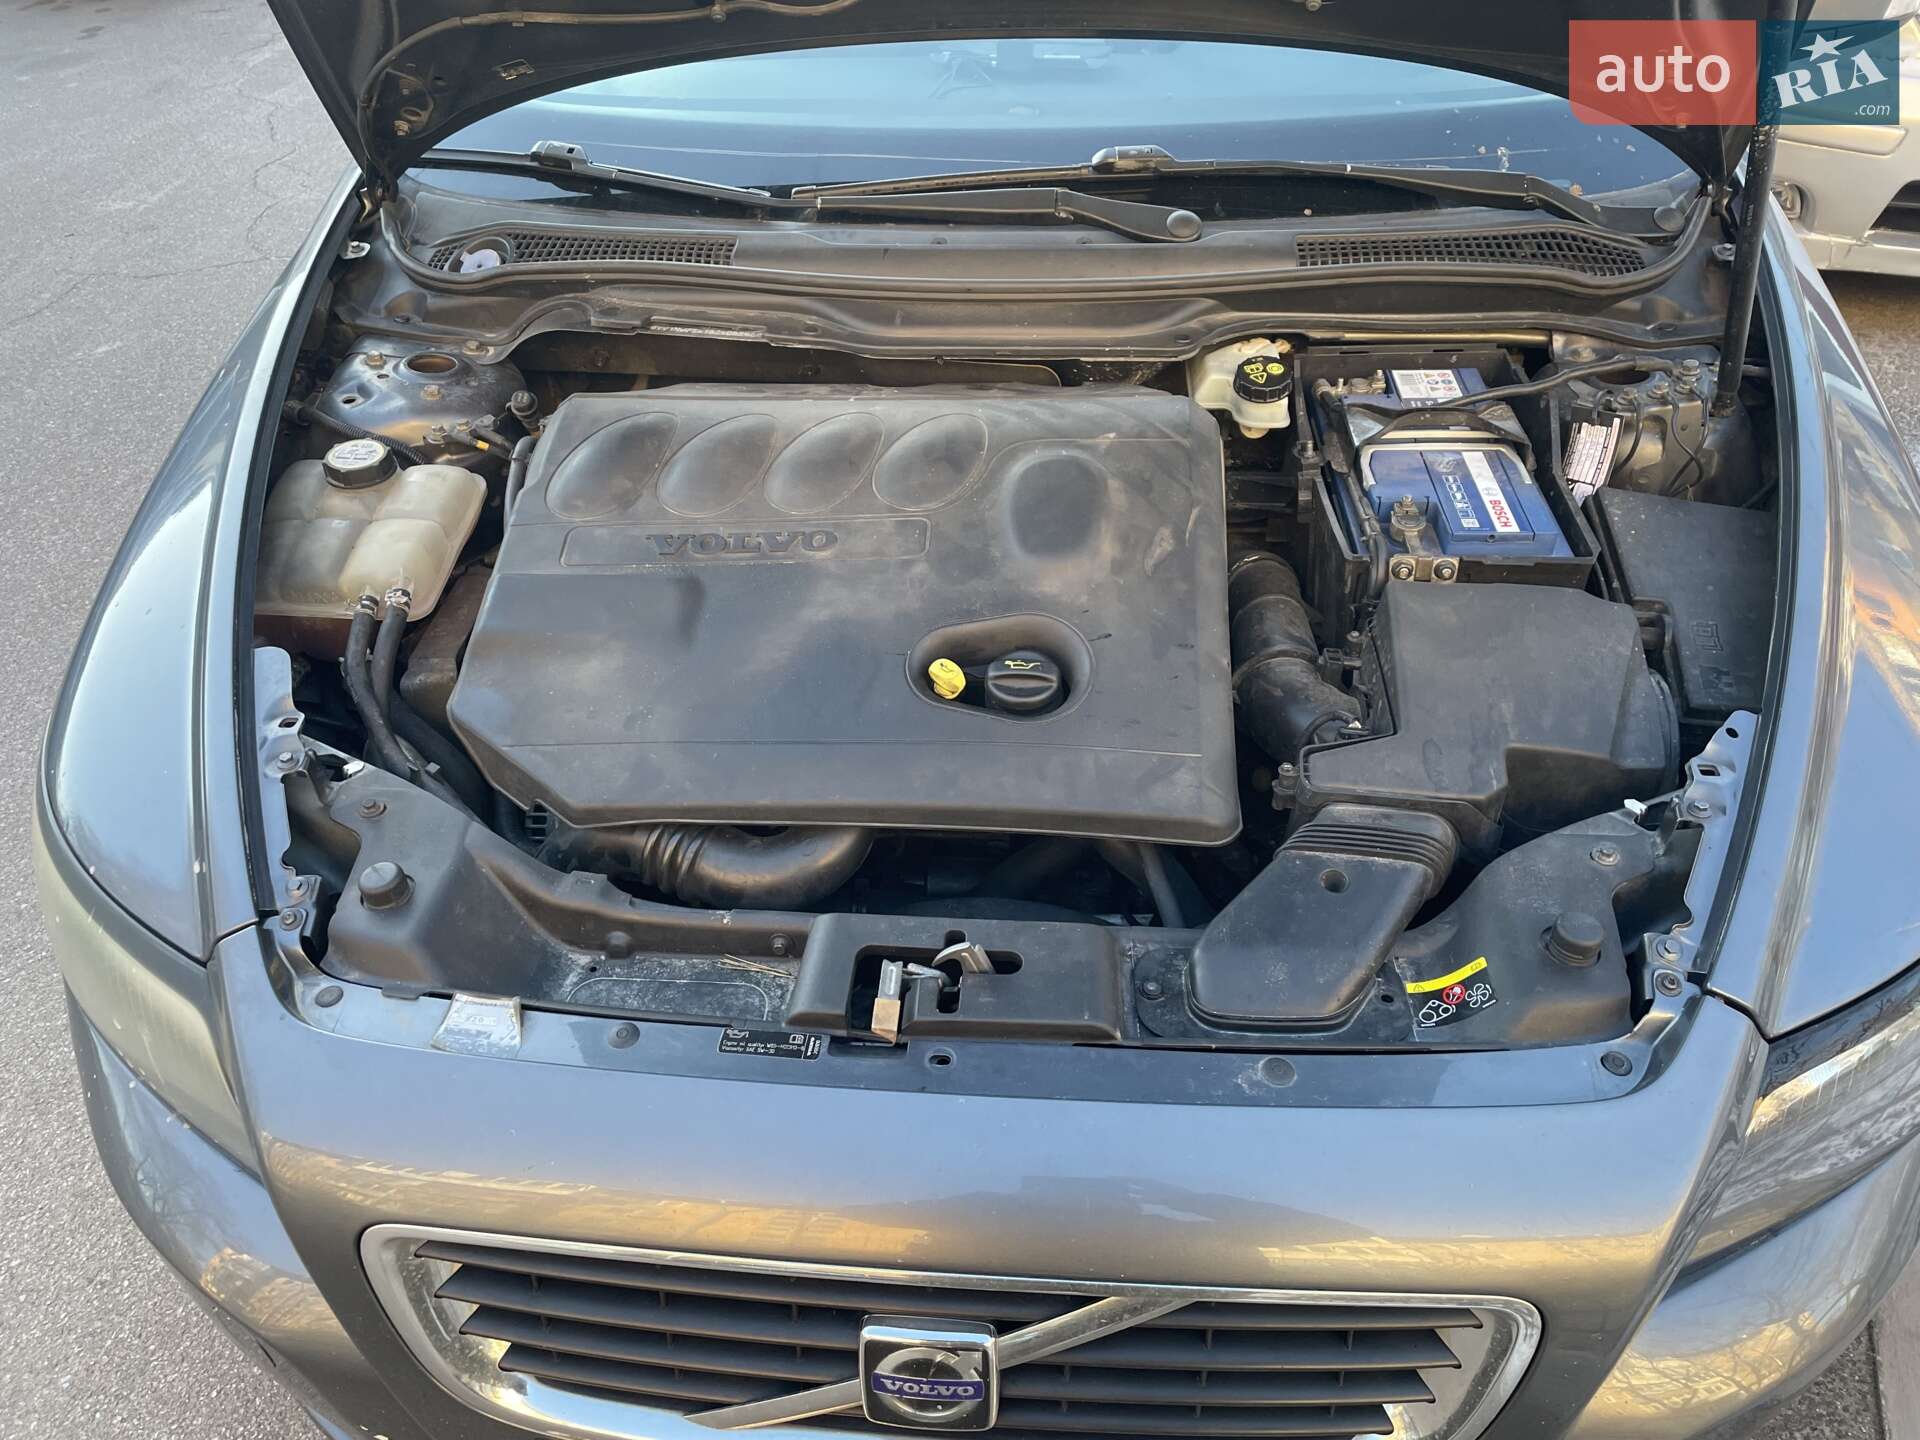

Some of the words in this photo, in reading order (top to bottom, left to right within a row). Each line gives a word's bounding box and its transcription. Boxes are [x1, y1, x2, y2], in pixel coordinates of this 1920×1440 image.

[1489, 501, 1512, 527] BOSCH
[645, 529, 839, 555] VOLVO
[880, 1379, 974, 1396] VOLVO
